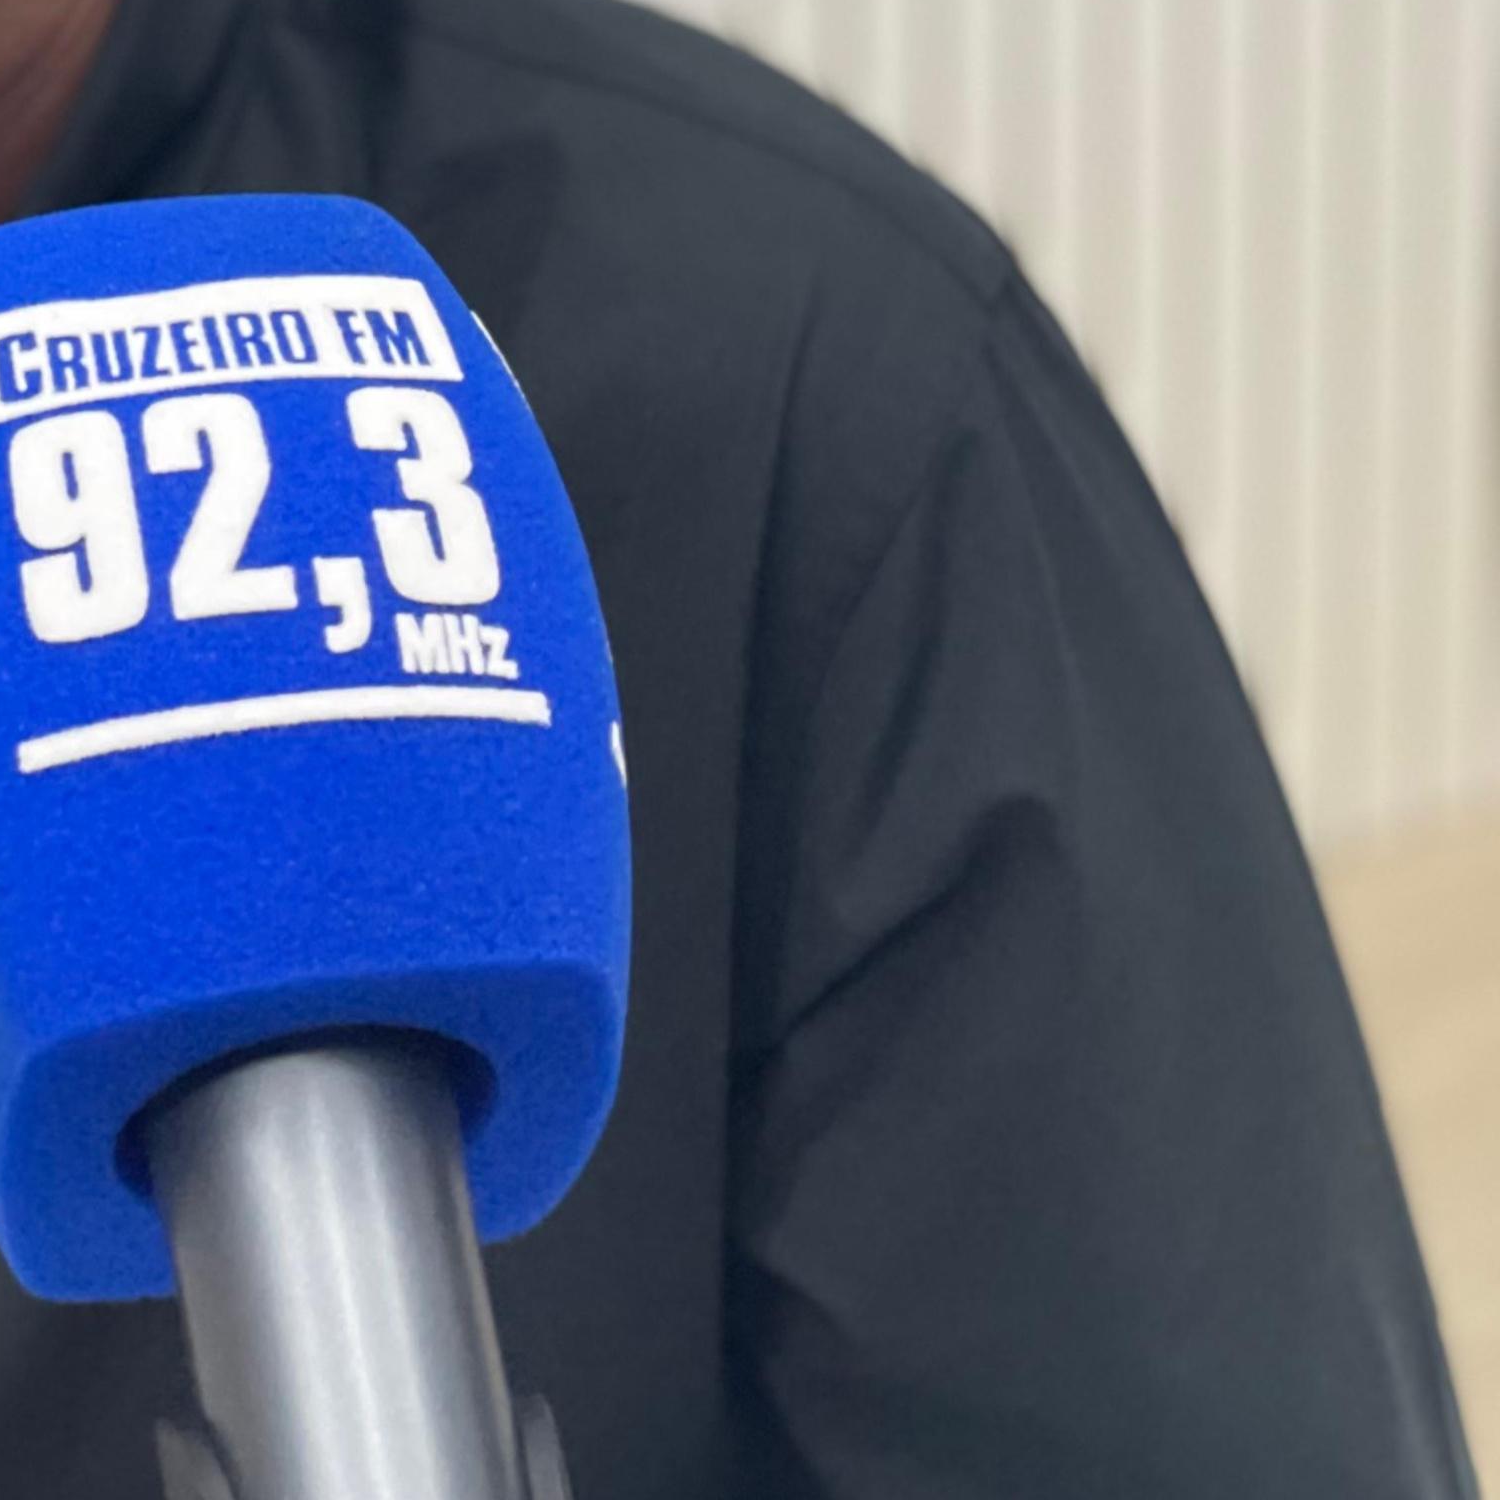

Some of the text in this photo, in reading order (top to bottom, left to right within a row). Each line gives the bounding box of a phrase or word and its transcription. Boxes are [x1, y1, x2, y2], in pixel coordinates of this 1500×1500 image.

[333, 309, 431, 366] FM
[8, 387, 501, 654] 92,3
[395, 612, 519, 680] MHz
